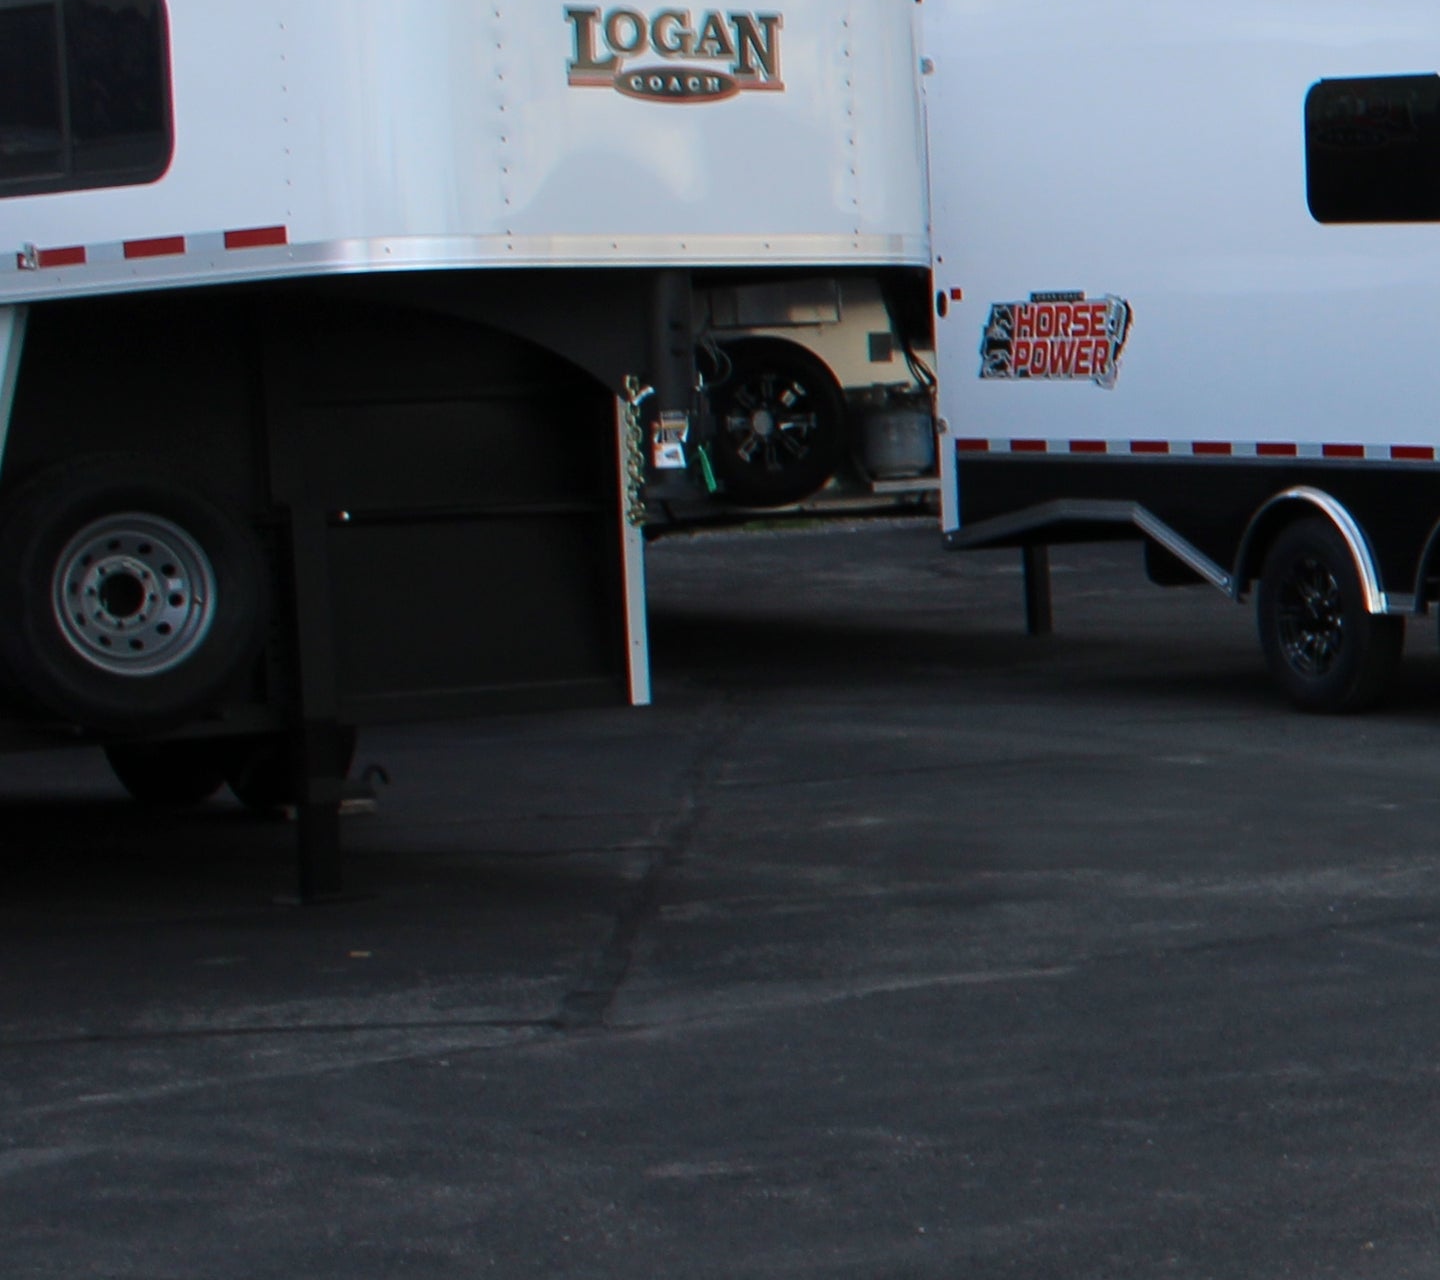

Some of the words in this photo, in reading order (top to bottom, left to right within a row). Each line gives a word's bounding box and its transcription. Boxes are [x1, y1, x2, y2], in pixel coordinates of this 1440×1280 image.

[564, 4, 784, 83] LOGAN
[629, 76, 721, 92] COACH
[1015, 303, 1107, 338] HORSE
[1014, 339, 1109, 376] POWER
